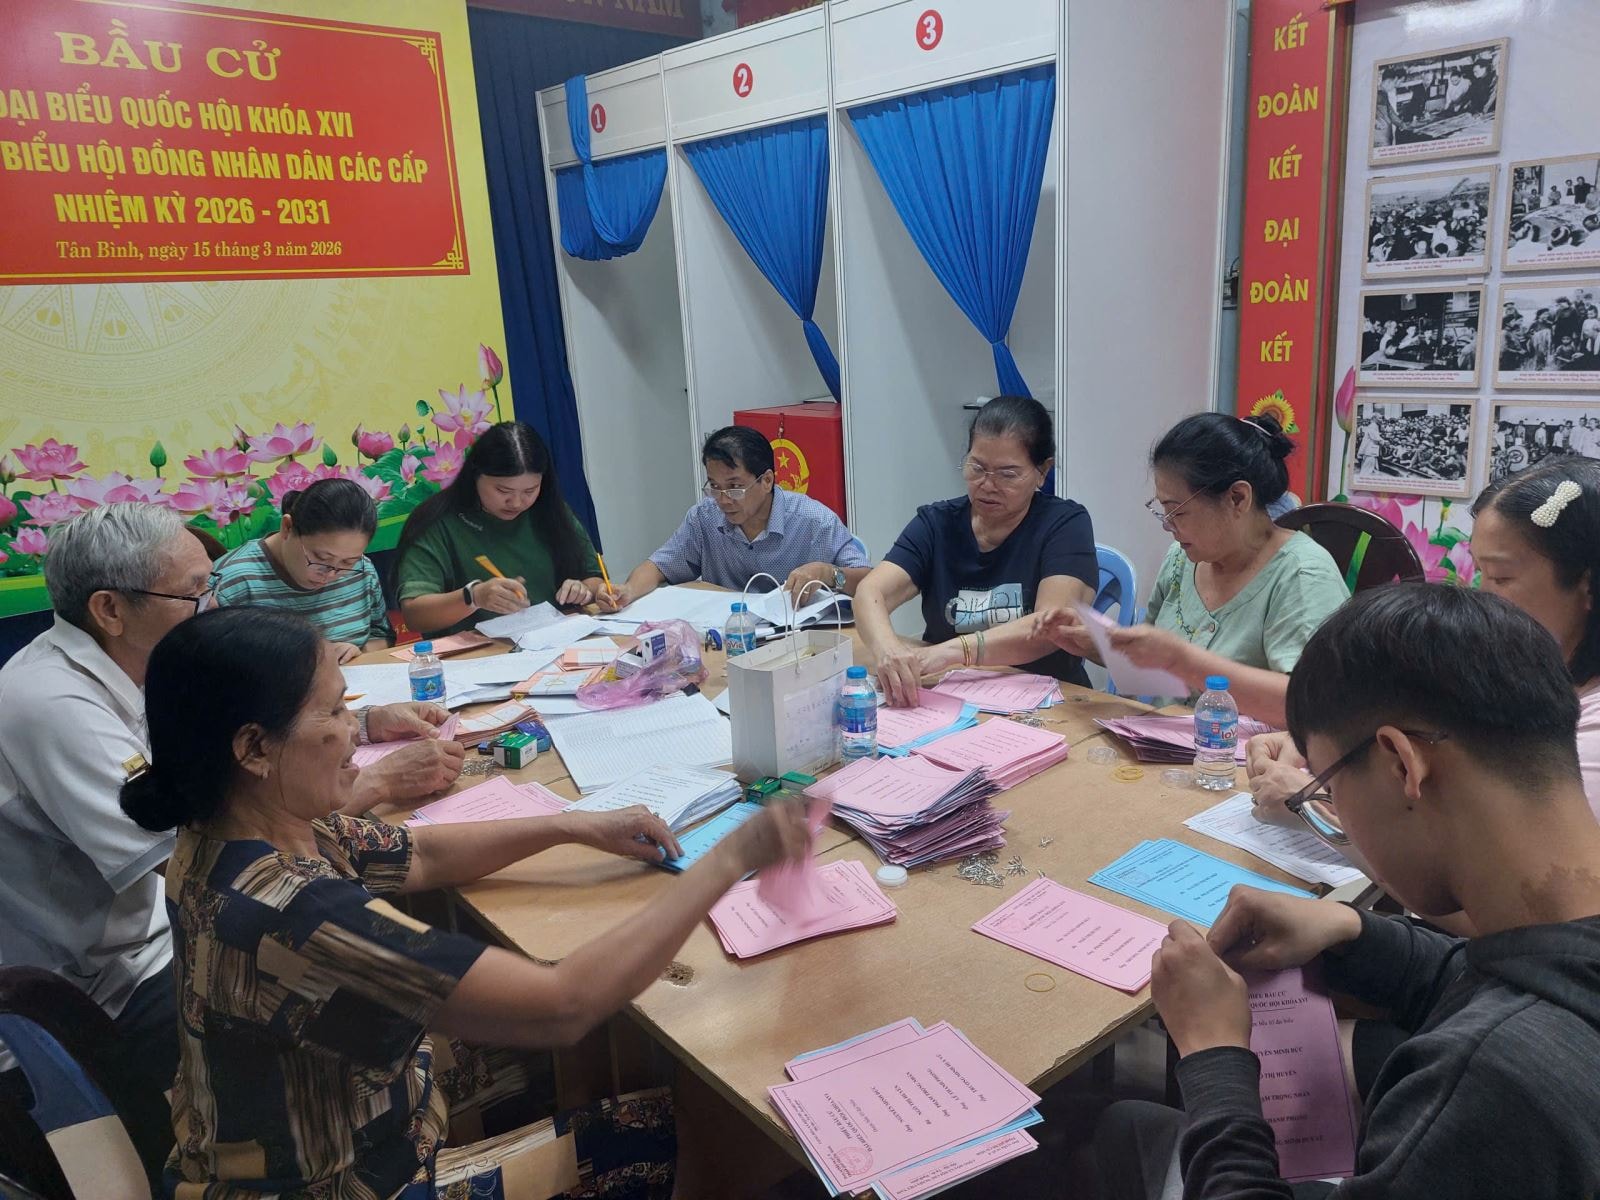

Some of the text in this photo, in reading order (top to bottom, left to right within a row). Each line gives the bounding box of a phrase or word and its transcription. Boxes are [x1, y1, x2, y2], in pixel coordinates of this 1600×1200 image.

[922, 16, 938, 44] 3
[1274, 12, 1309, 51] KẾT
[54, 18, 281, 81] BẦU CỬ
[737, 69, 749, 93] 2
[45, 82, 113, 124] BIỂU
[120, 89, 193, 128] QUỐC
[198, 98, 242, 137] HỘI
[247, 103, 313, 136] KHÓA
[316, 110, 354, 138] XVI
[1258, 83, 1318, 118] ĐOÀN
[594, 107, 603, 130] 1
[0, 130, 429, 184] BIỂU HỘI ĐỒNG NHÂN DÂN CÁC CẤP
[1268, 144, 1303, 180] KẾT
[54, 189, 149, 229] NHIỆM
[153, 191, 186, 224] KỲ
[195, 197, 255, 225] 2026
[278, 198, 331, 225] 2031
[1264, 217, 1300, 248] ĐẠI
[56, 240, 342, 261] Tân Bình, ngày 15 tháng 3 năm 2026
[1250, 273, 1309, 304] ĐOÀN
[1260, 331, 1293, 362] KẾT
